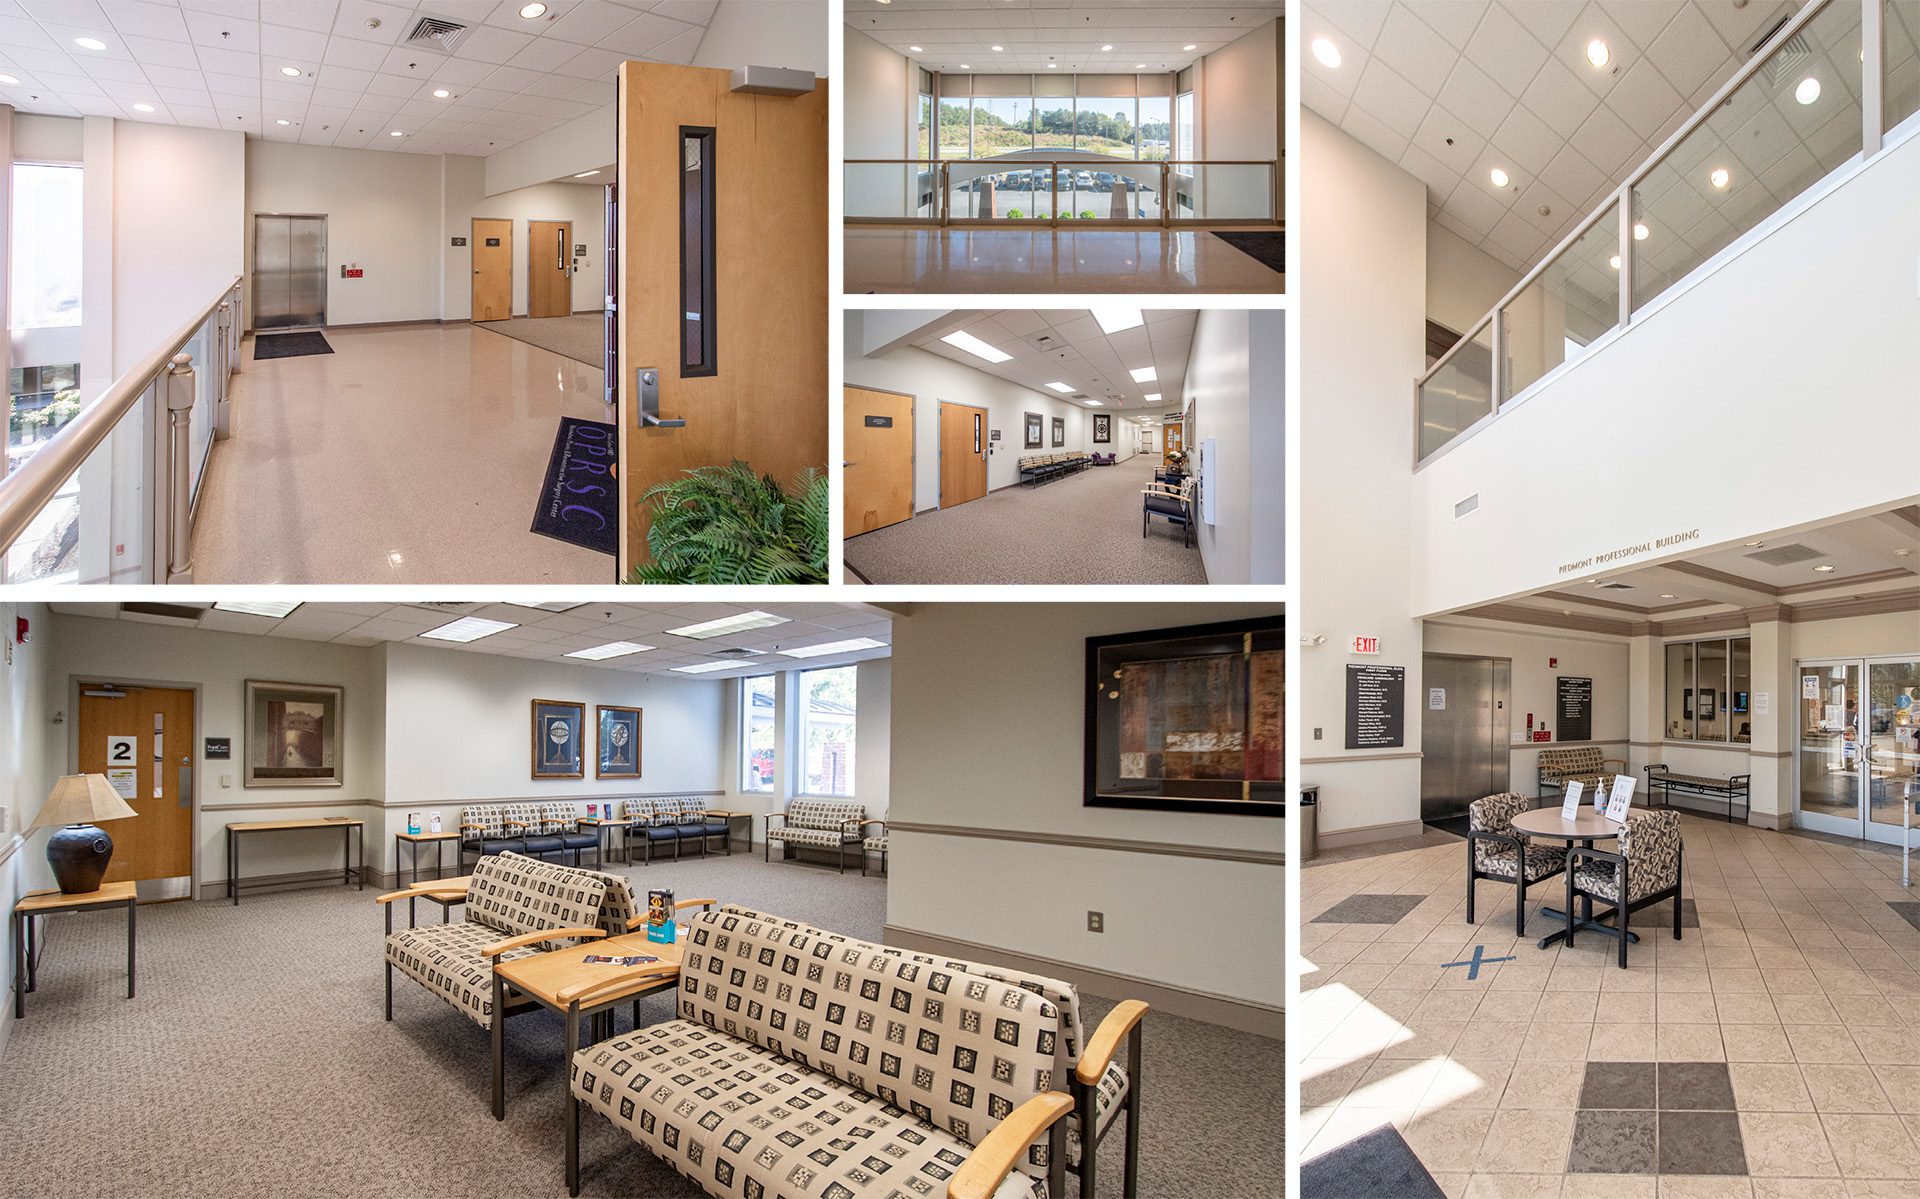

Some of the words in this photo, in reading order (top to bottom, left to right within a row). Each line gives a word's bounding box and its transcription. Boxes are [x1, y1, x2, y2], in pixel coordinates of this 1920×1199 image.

[561, 426, 607, 530] OPRSC
[1558, 558, 1592, 574] PIEDMONT
[1595, 542, 1651, 565] PROFESSIONAL
[1656, 529, 1699, 548] BUILDING
[1356, 637, 1377, 653] EXIT
[113, 742, 131, 760] 2
